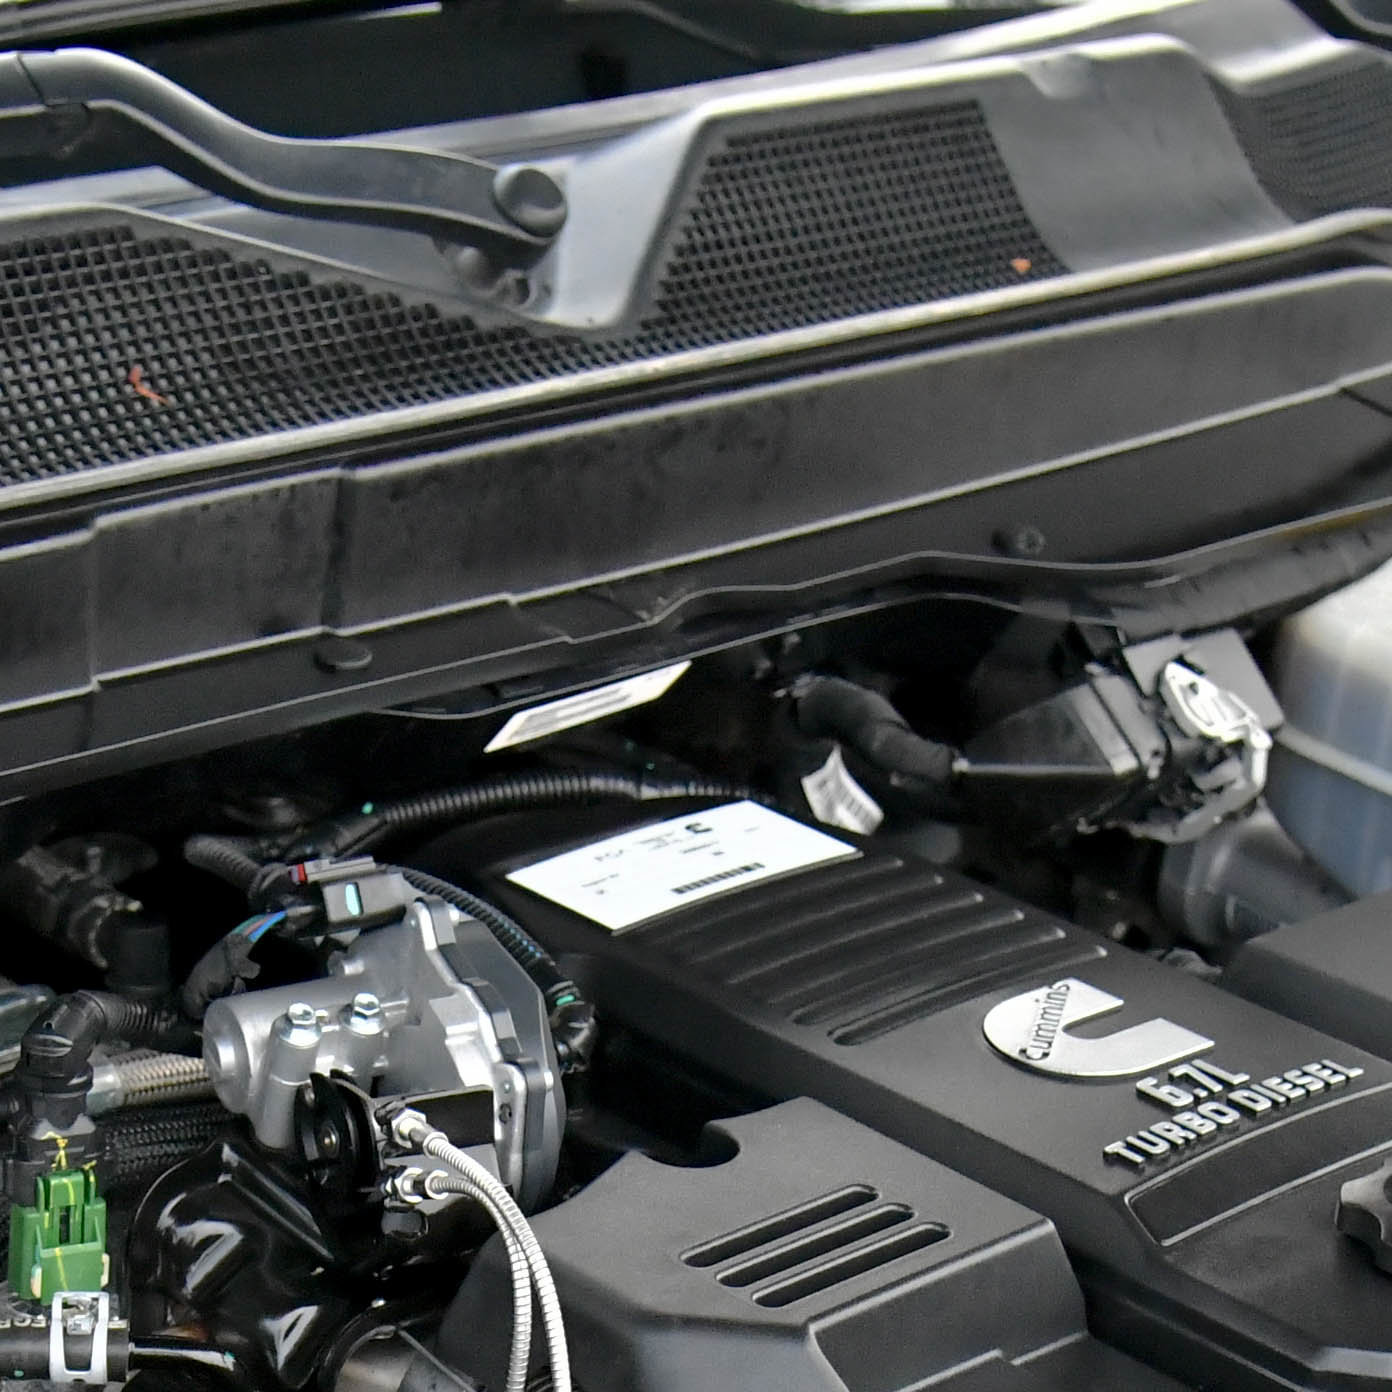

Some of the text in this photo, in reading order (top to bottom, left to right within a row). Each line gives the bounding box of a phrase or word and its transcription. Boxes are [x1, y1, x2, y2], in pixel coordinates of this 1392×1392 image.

[1018, 980, 1071, 1061] Cummins
[1103, 1058, 1365, 1167] TURBO DIESEL
[1135, 1058, 1251, 1108] 6.7L
